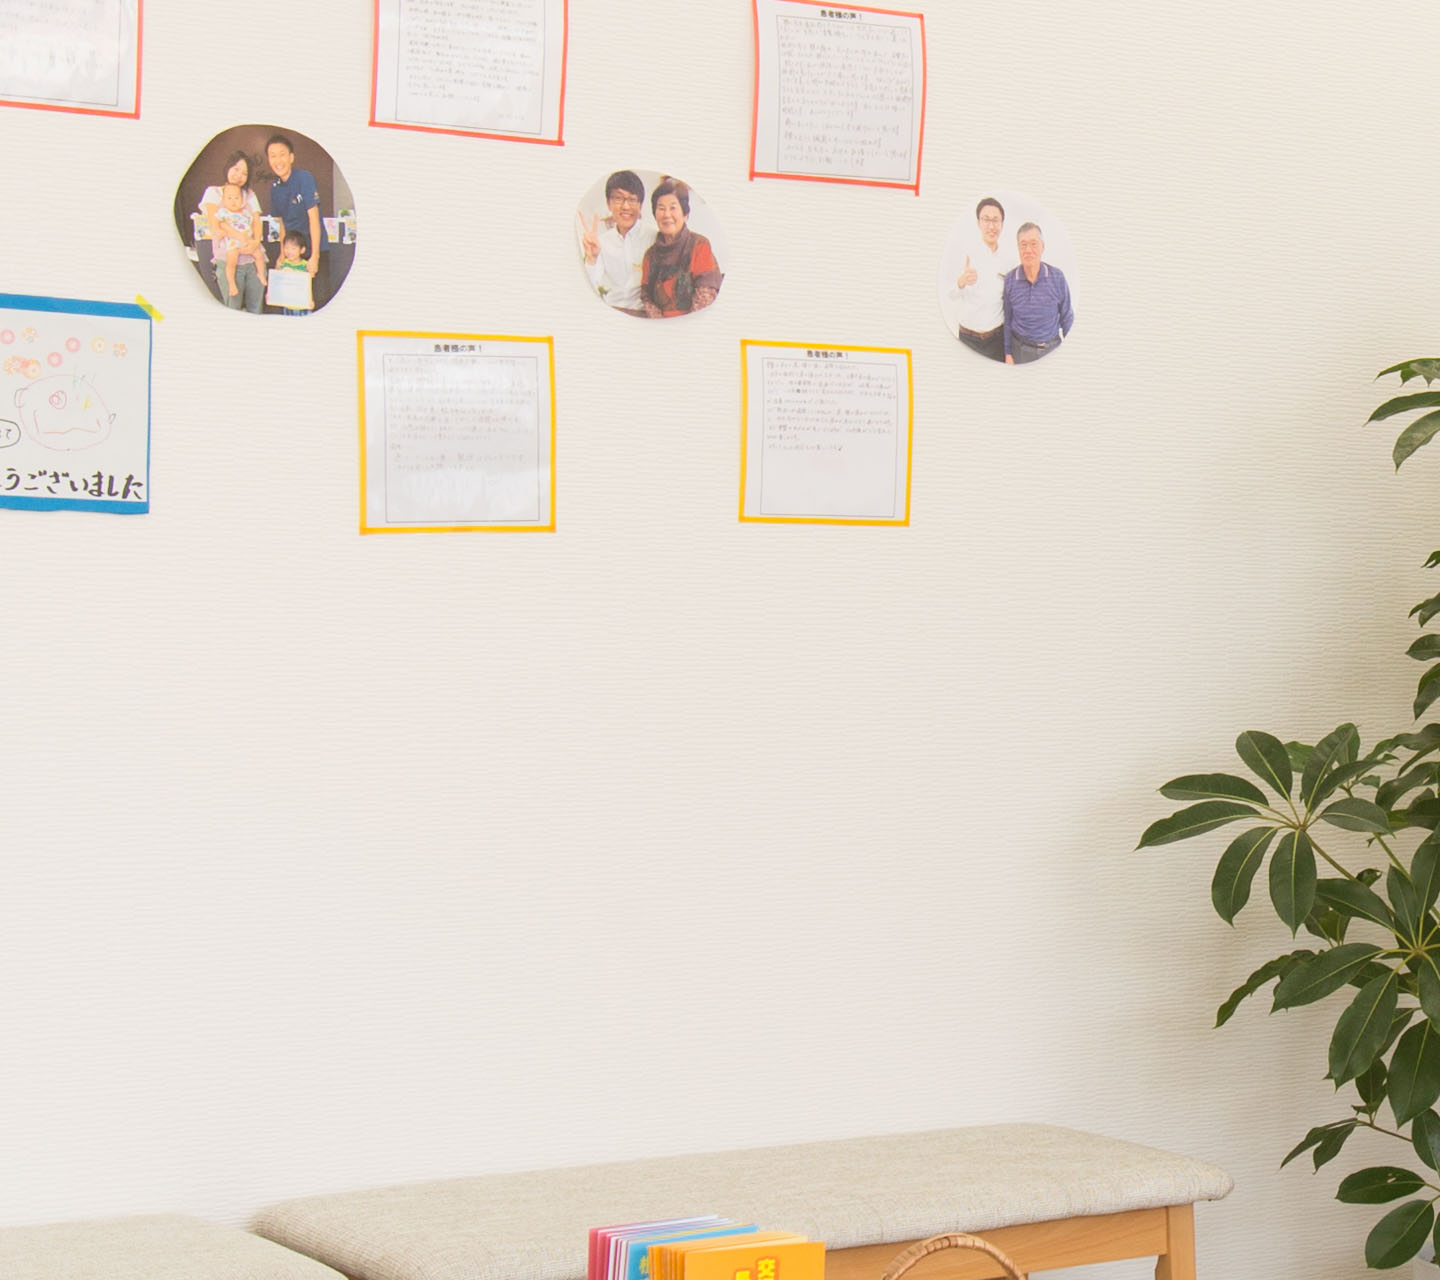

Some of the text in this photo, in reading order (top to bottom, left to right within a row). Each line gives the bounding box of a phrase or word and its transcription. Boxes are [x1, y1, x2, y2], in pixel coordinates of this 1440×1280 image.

[821, 9, 863, 21] 患者様の声！
[434, 344, 483, 353] 患者様の声！
[807, 350, 849, 360] 患者様の声！
